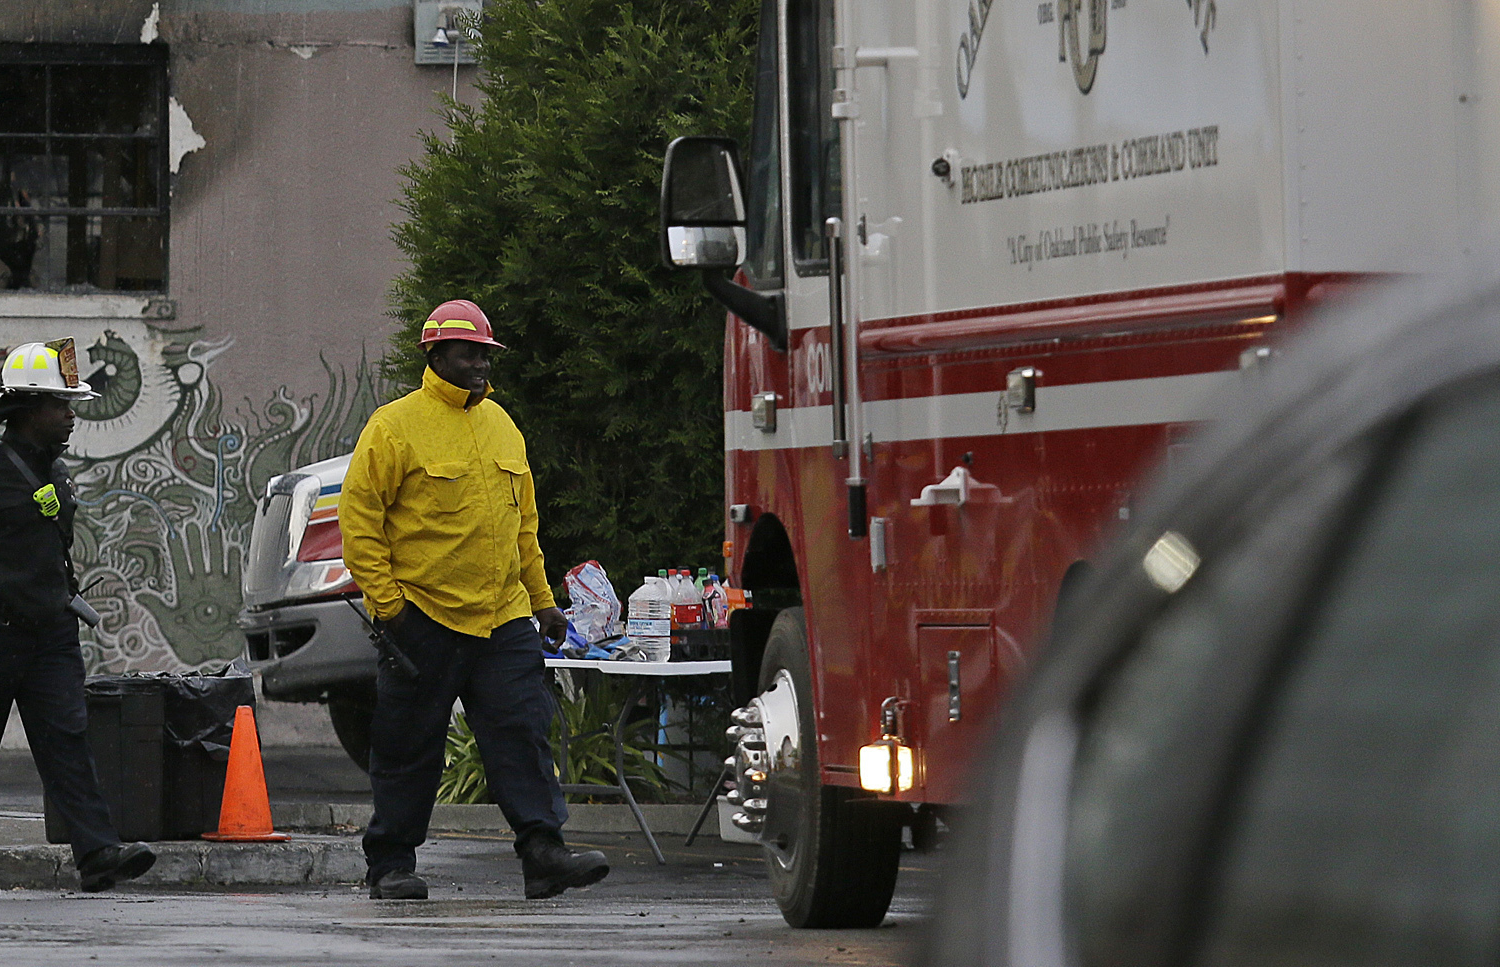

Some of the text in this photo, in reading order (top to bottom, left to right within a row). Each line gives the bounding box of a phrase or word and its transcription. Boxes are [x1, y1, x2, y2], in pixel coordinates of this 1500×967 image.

[961, 125, 1219, 205] MOBILE COMMUNICATIONS & COMMAND UNIT
[1017, 234, 1033, 272] City
[1034, 230, 1043, 261] of
[1044, 226, 1077, 260] Oakland
[1078, 223, 1101, 255] Public
[1103, 219, 1129, 260] Safety
